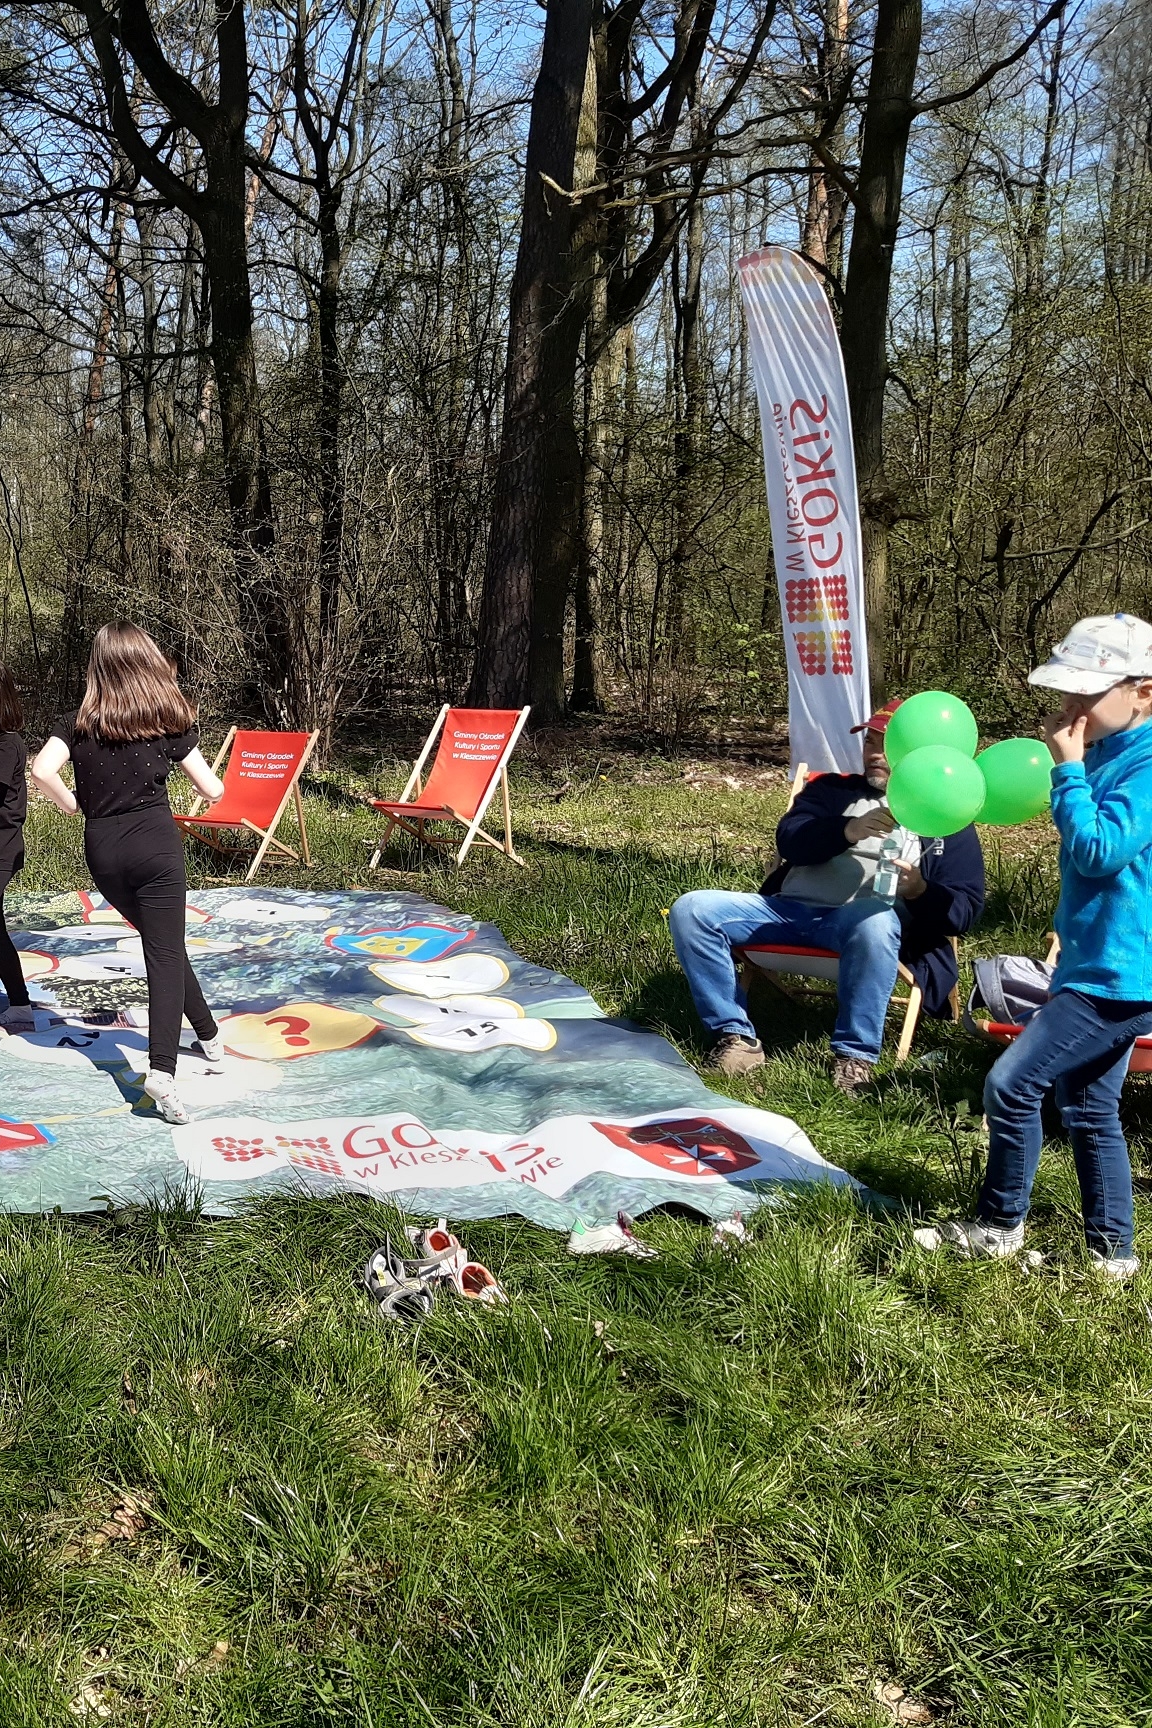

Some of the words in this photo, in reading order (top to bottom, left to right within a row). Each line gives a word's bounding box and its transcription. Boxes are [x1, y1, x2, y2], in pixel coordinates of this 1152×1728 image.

[453, 731, 478, 741] Gminny
[478, 732, 505, 740] Ośrodek
[454, 741, 476, 750] Kultury
[480, 743, 501, 751] Sportu
[241, 751, 266, 760] Gminny
[266, 752, 295, 760] Ośrodek
[241, 761, 264, 770] Kultury
[267, 762, 289, 770] Sportu
